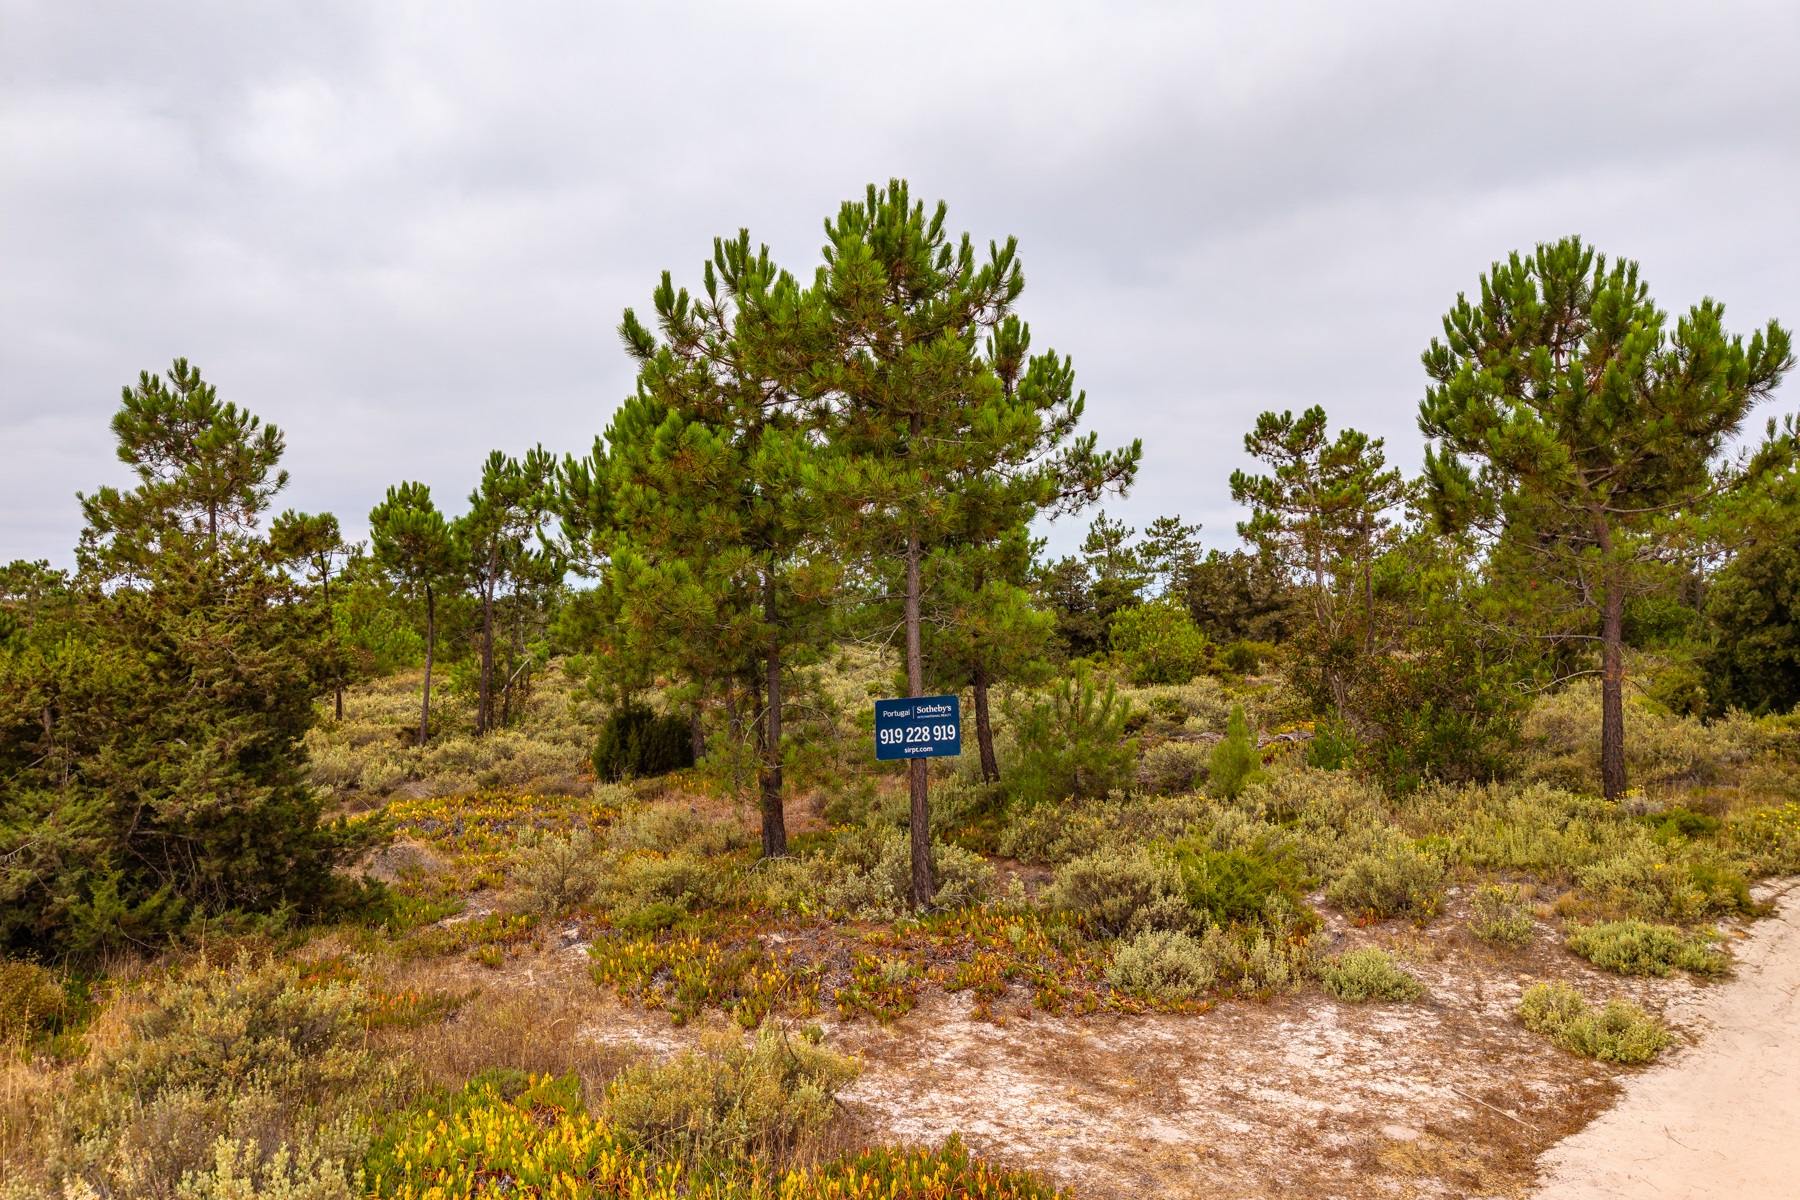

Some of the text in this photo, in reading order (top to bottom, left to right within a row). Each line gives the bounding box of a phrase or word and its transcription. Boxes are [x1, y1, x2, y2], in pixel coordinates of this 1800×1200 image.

[883, 709, 910, 718] Portugal
[916, 704, 952, 714] Sotheby's
[880, 724, 956, 744] 919 228 919
[904, 746, 933, 754] sirpt.com
